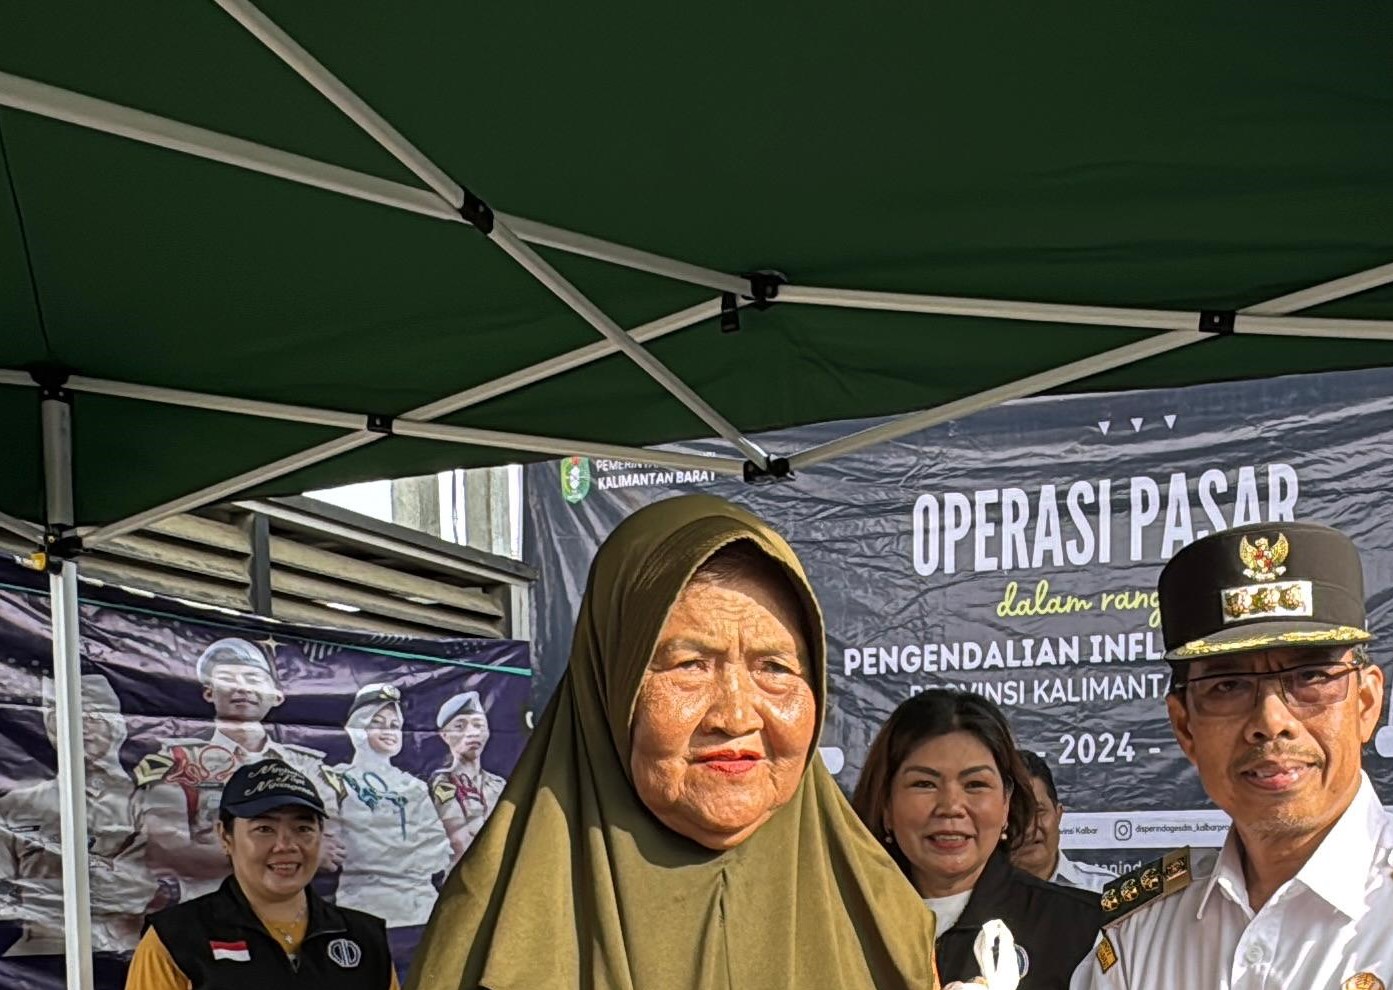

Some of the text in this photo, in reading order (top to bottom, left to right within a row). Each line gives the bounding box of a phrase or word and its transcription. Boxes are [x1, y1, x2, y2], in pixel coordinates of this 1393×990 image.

[597, 471, 674, 490] KALIMANTAN
[913, 463, 1299, 577] OPERASI PASAR
[996, 579, 1161, 628] dalam rang
[843, 631, 1167, 676] PENGENDALIAN INFL
[1033, 673, 1171, 705] KALIMANT
[1058, 732, 1136, 765] 2024
